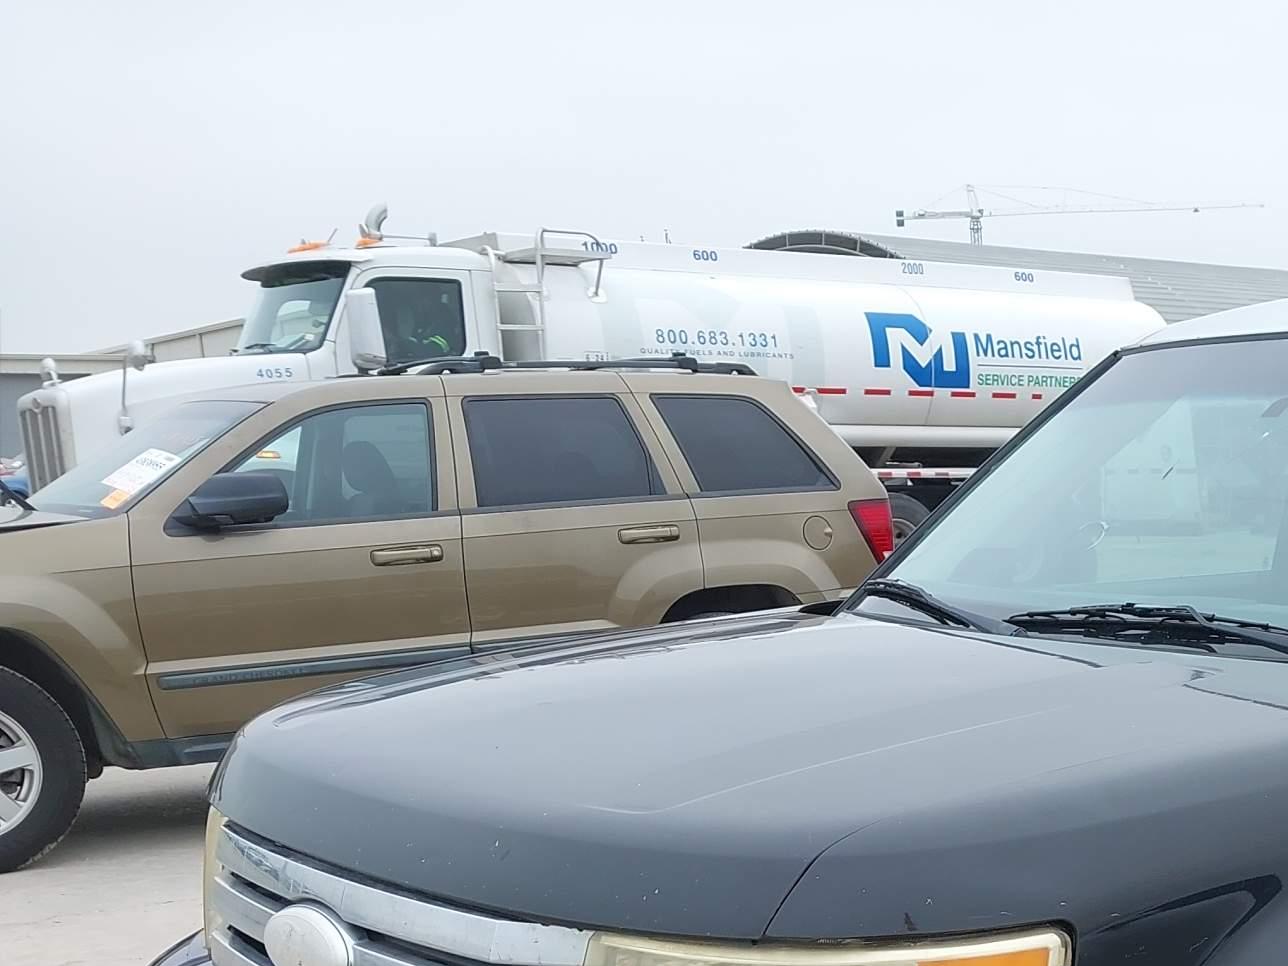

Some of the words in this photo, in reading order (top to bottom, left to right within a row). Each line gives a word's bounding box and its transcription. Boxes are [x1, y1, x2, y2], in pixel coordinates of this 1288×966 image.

[693, 249, 718, 261] 600
[901, 262, 924, 275] 2000
[1014, 271, 1034, 283] 600
[655, 328, 778, 348] 800.683.1331
[973, 333, 1082, 361] Mansfield
[739, 350, 794, 360] LUBRICANTS
[256, 367, 293, 378] 4055
[977, 373, 1024, 387] SERVICE
